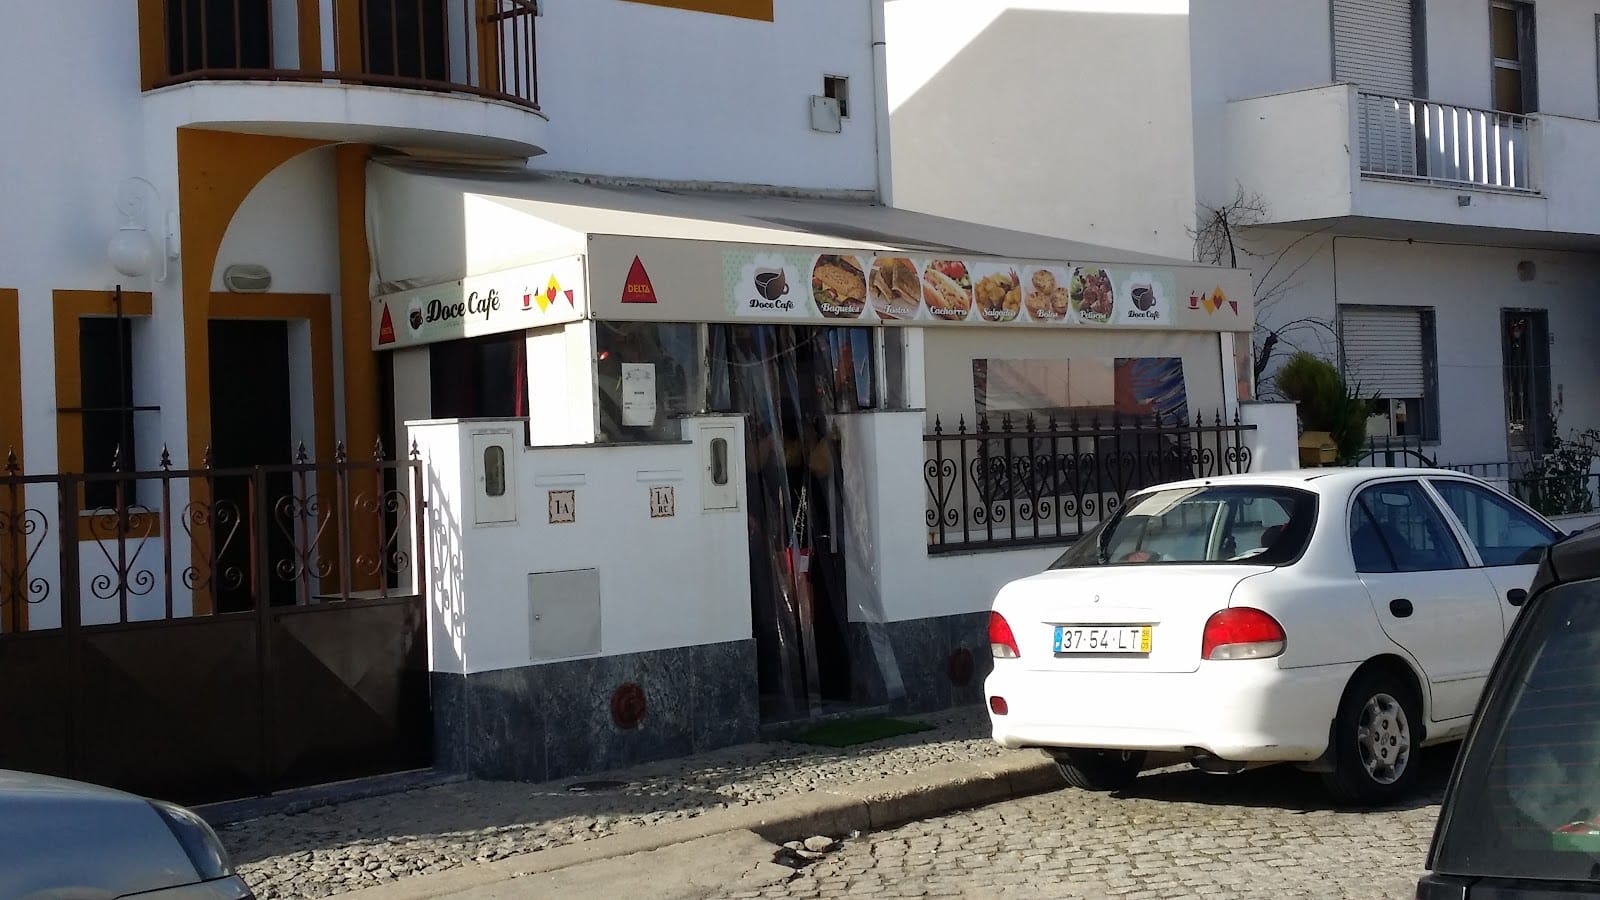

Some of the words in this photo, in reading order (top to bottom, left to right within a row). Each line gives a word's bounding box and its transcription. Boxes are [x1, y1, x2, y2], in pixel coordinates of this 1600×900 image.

[628, 284, 650, 293] DELTA
[426, 300, 466, 323] Doce
[467, 288, 500, 320] Café
[749, 299, 774, 309] Doce
[775, 299, 794, 312] Café
[821, 302, 860, 315] Baguetes
[930, 305, 967, 316] Cachorro
[1128, 310, 1145, 318] Doce
[1146, 310, 1160, 320] Café
